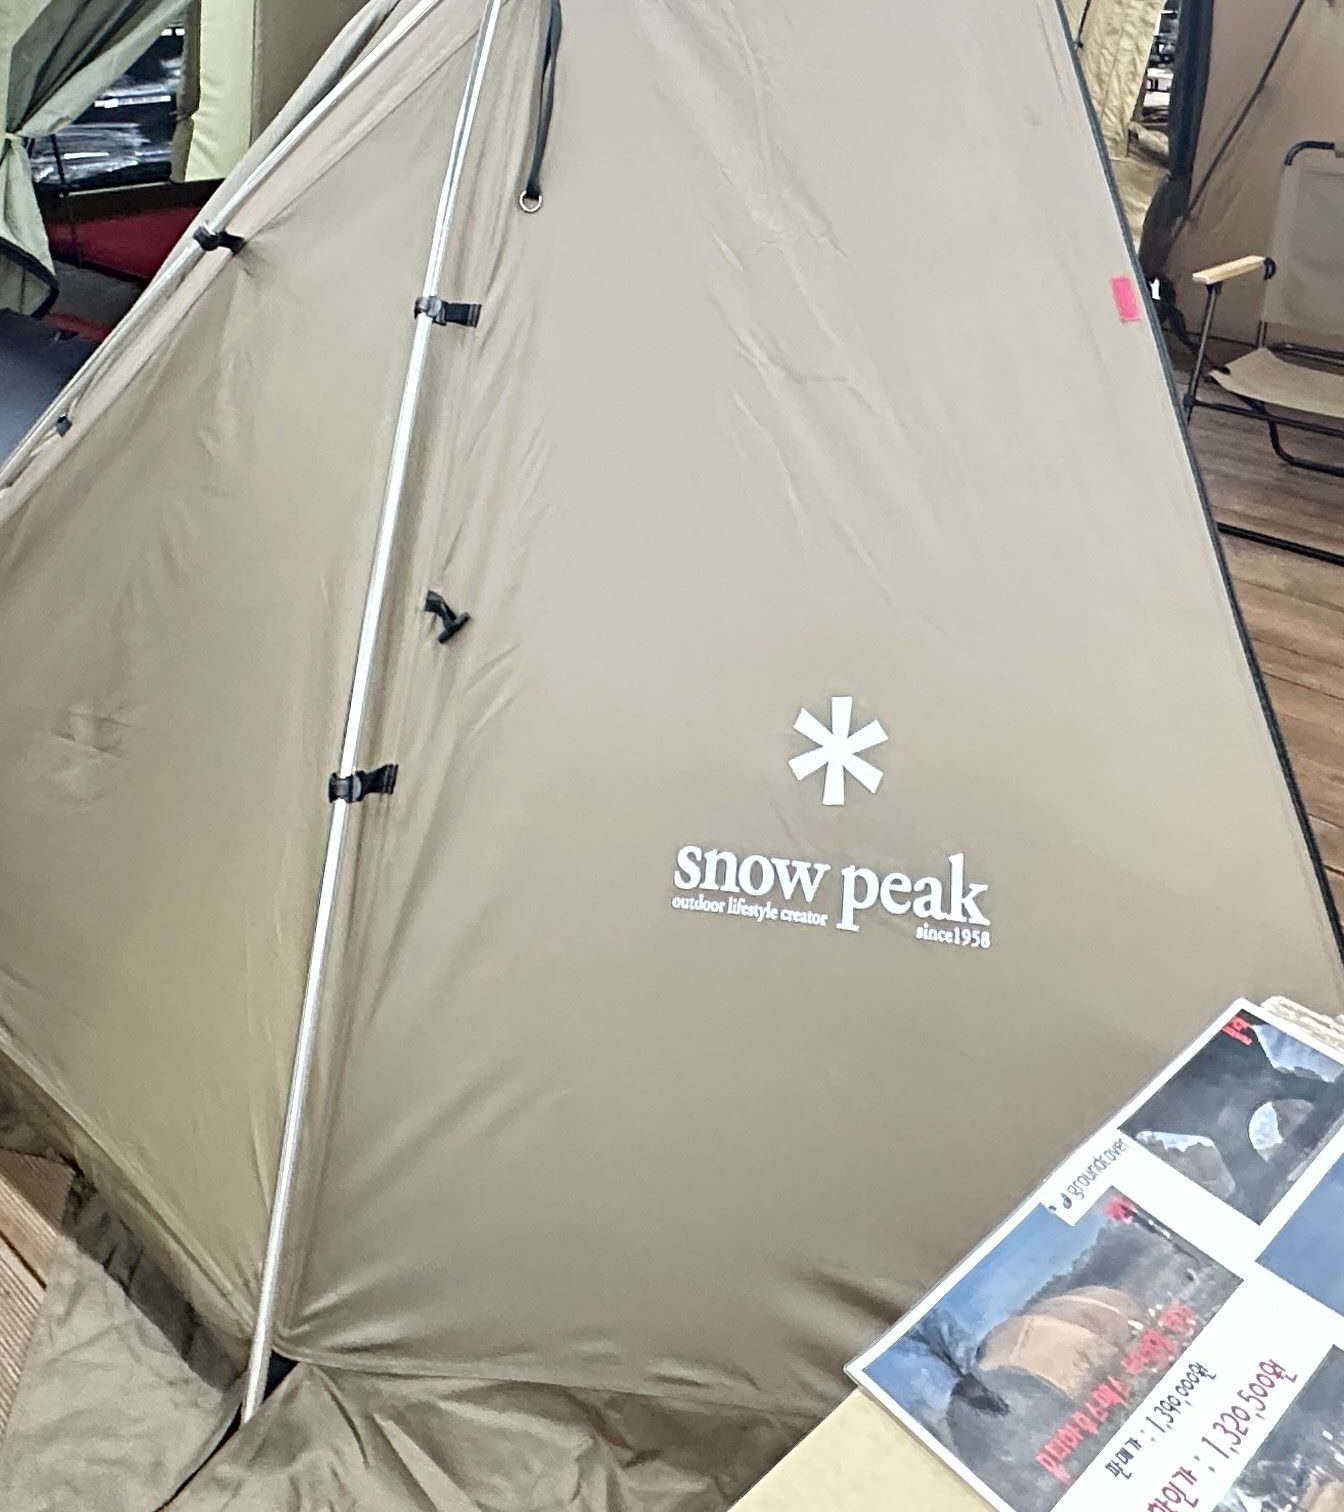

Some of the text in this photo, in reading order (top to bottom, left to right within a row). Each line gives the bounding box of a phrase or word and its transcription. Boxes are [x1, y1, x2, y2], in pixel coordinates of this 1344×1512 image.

[671, 893, 828, 927] outdoor lifestyle creator
[673, 844, 991, 932] snow peak
[915, 922, 991, 949] since1958
[1104, 1437, 1142, 1480] 판매가
[1145, 1361, 1217, 1434] 1,390,000원
[1201, 1358, 1299, 1460] 1,320,500원
